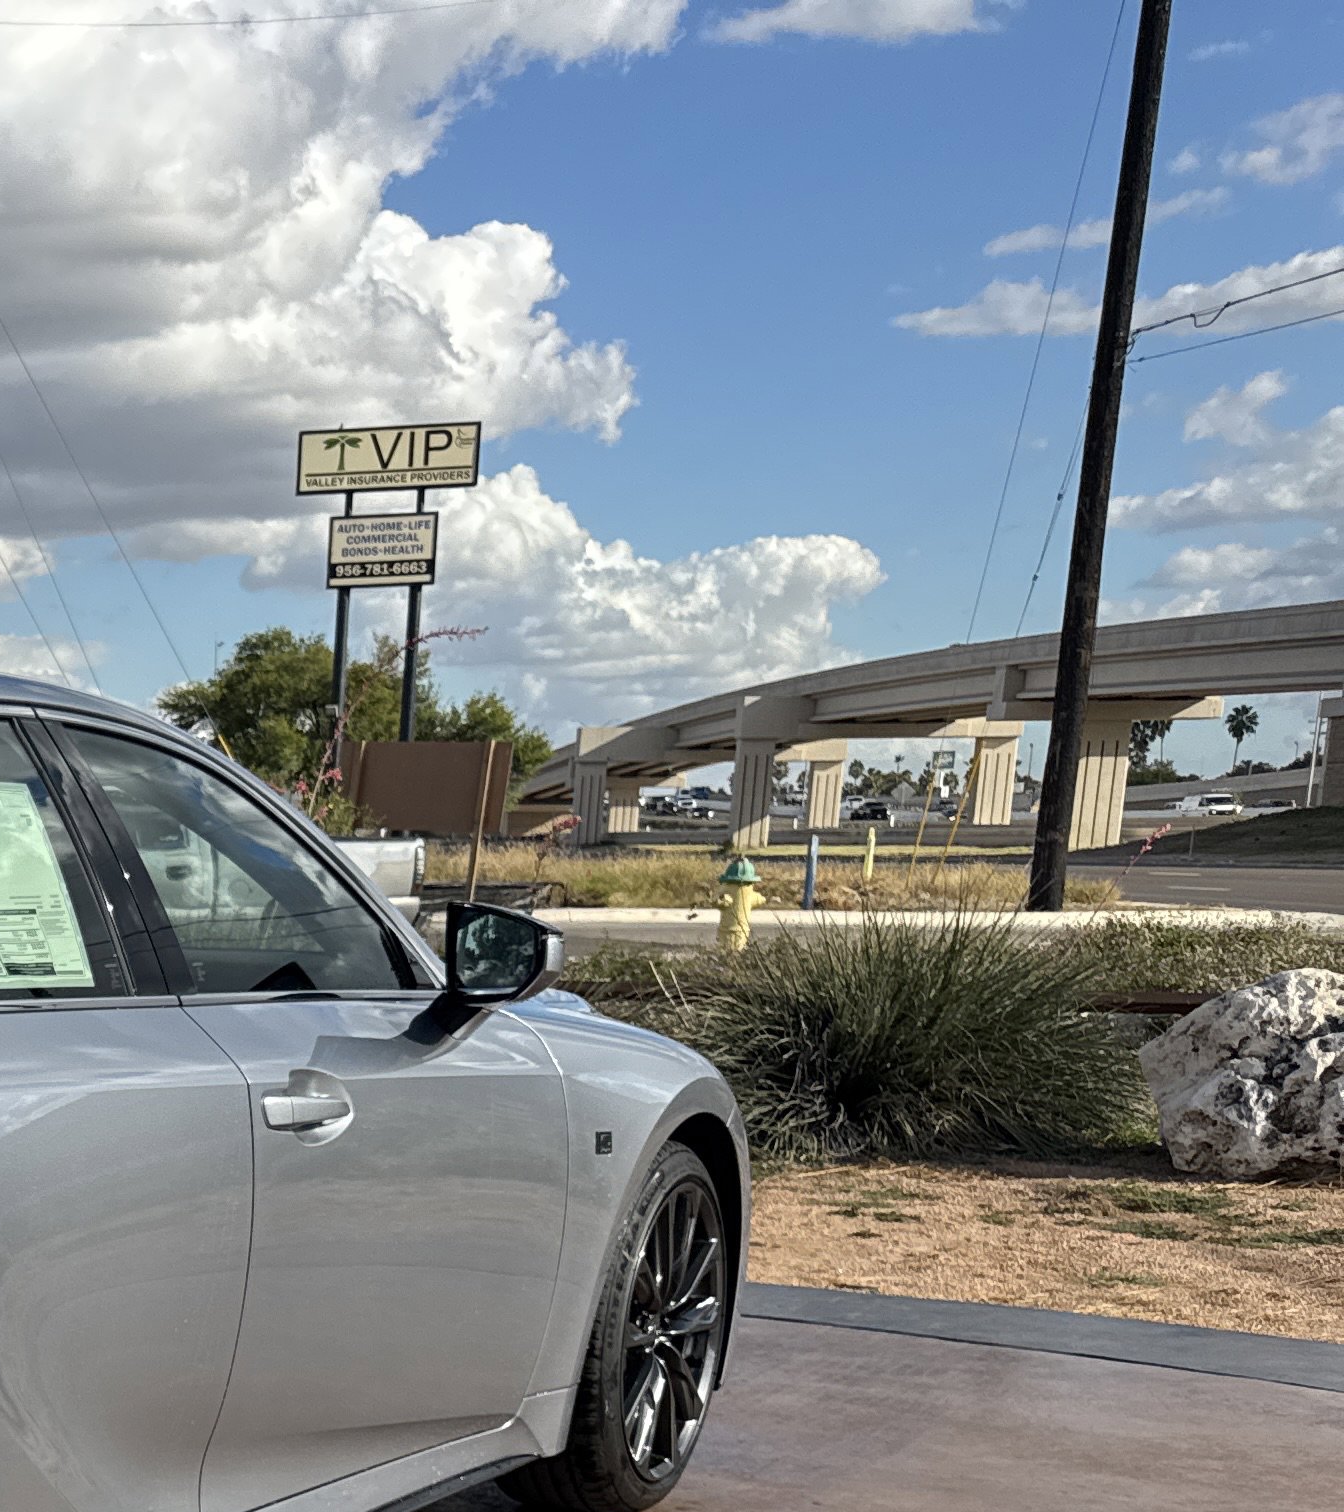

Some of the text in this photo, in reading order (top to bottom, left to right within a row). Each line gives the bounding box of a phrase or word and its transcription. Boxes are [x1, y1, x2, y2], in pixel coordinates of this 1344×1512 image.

[370, 429, 453, 470] VIP
[305, 469, 471, 488] VALLEY INSURANCE PROVIDERS
[346, 532, 420, 546] COMMERCIAL
